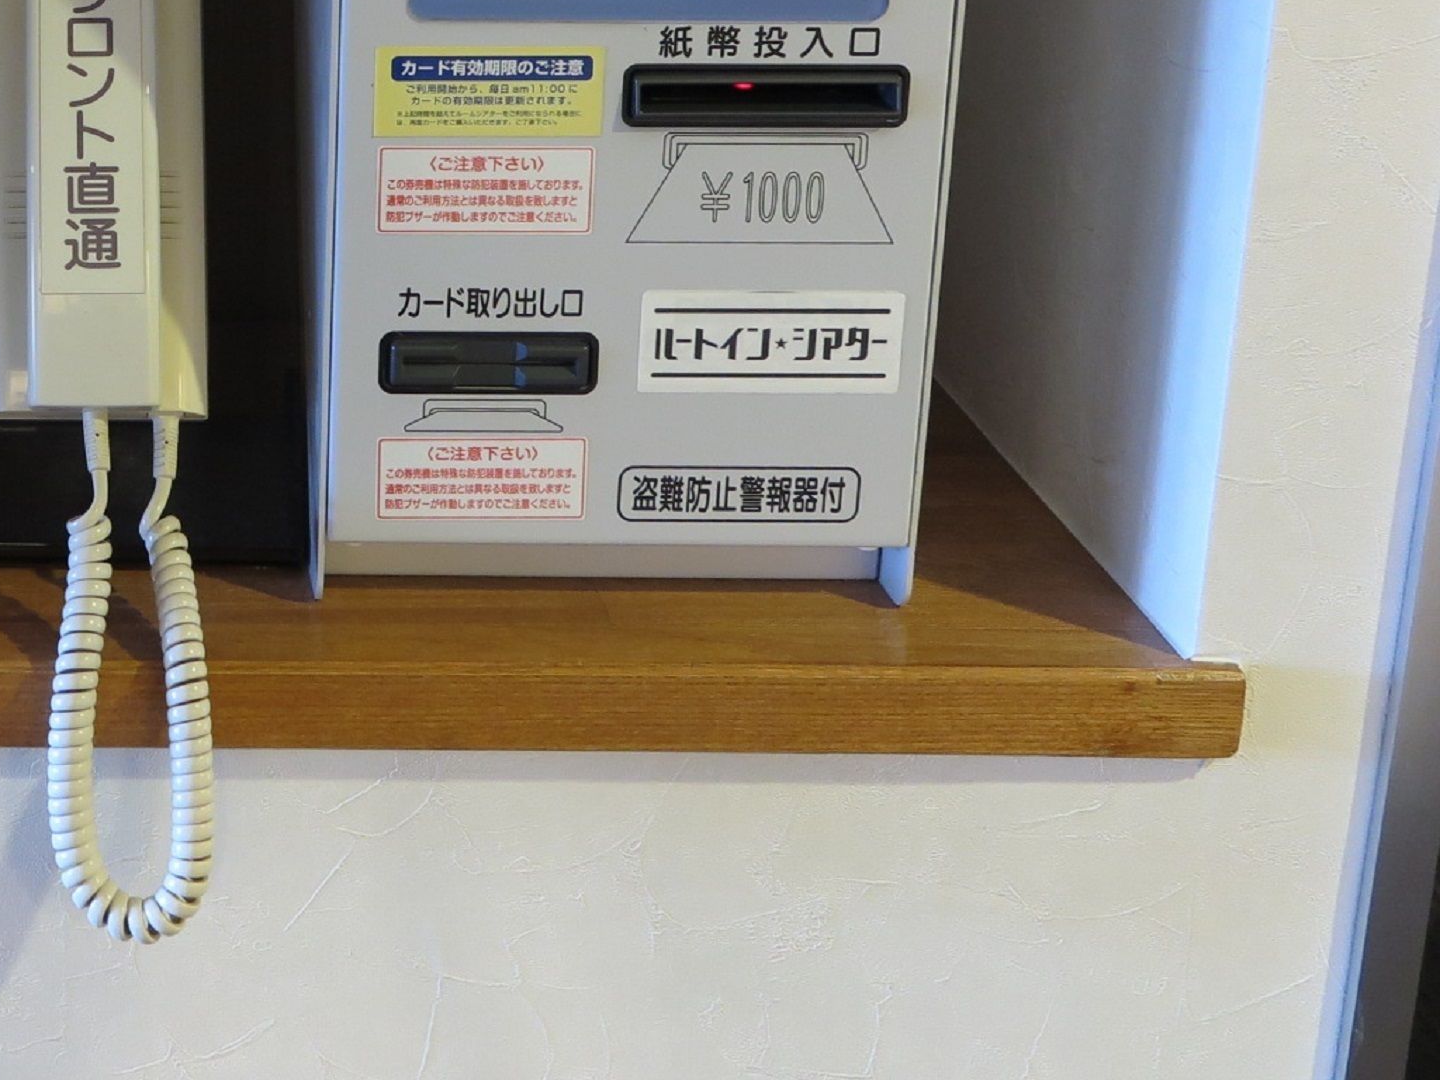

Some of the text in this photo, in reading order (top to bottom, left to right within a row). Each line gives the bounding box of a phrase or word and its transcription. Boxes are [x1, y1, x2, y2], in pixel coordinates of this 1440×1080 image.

[659, 25, 881, 59] 紙幣投入口
[401, 59, 585, 77] カード有効期限のご注意
[699, 171, 825, 224] ¥1000
[397, 287, 584, 319] カード取り出し口
[631, 474, 847, 514] 盗難防止警報器付
